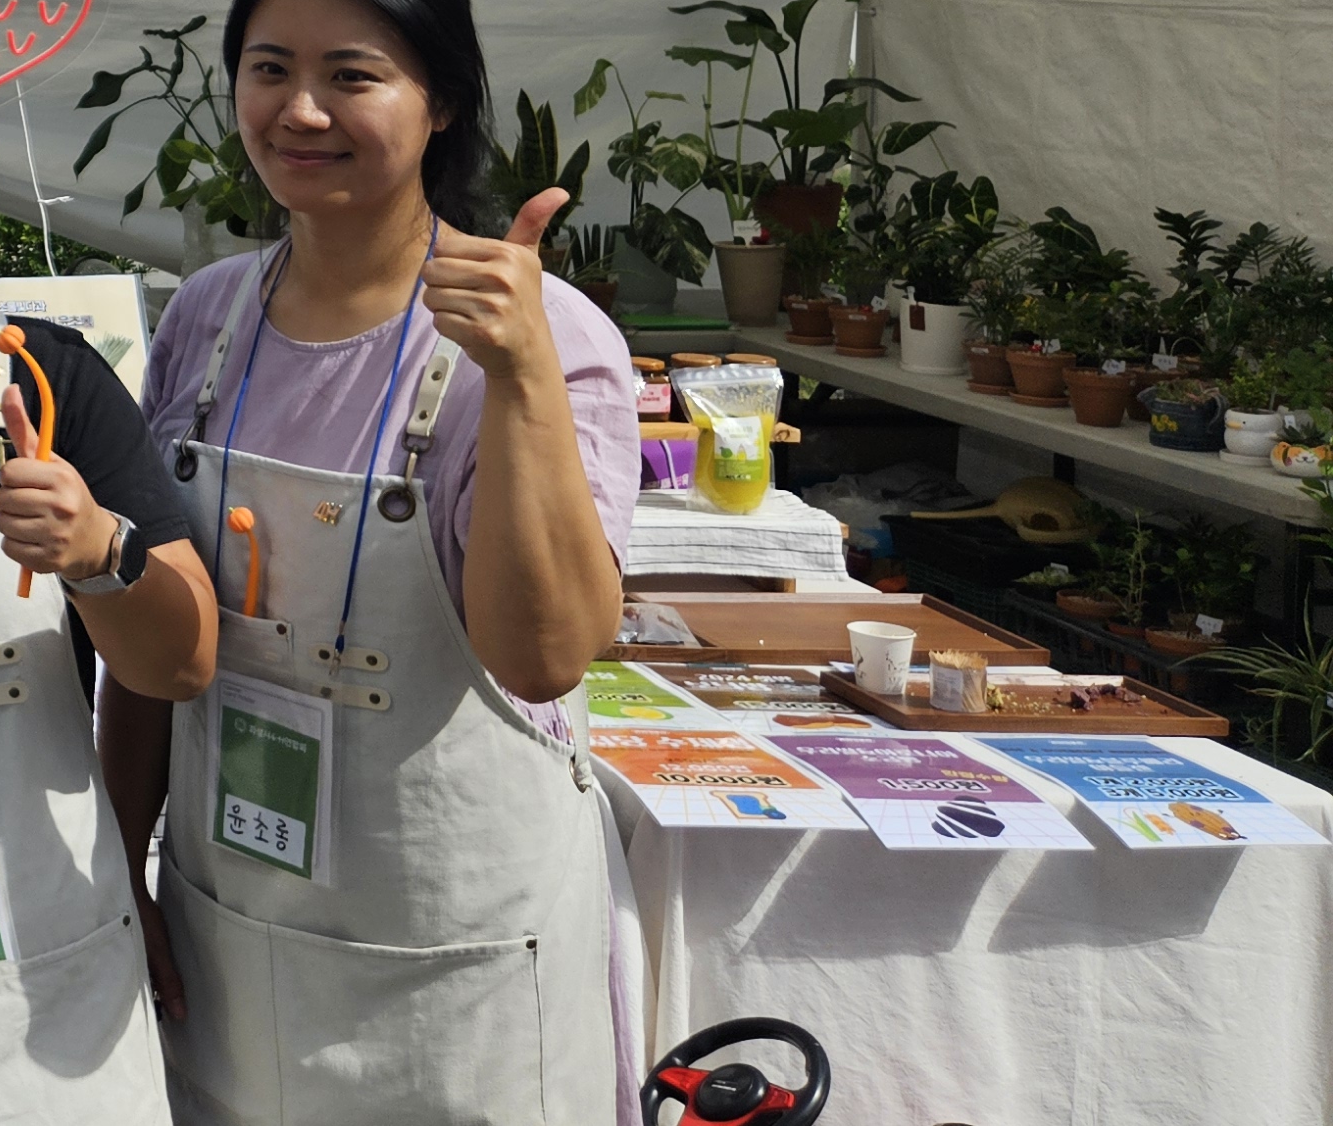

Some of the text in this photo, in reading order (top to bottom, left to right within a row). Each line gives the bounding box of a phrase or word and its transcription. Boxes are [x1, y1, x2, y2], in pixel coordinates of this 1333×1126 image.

[656, 772, 788, 787] 10,000원
[880, 778, 989, 793] 1,500원
[1147, 787, 1240, 800] 5,000원
